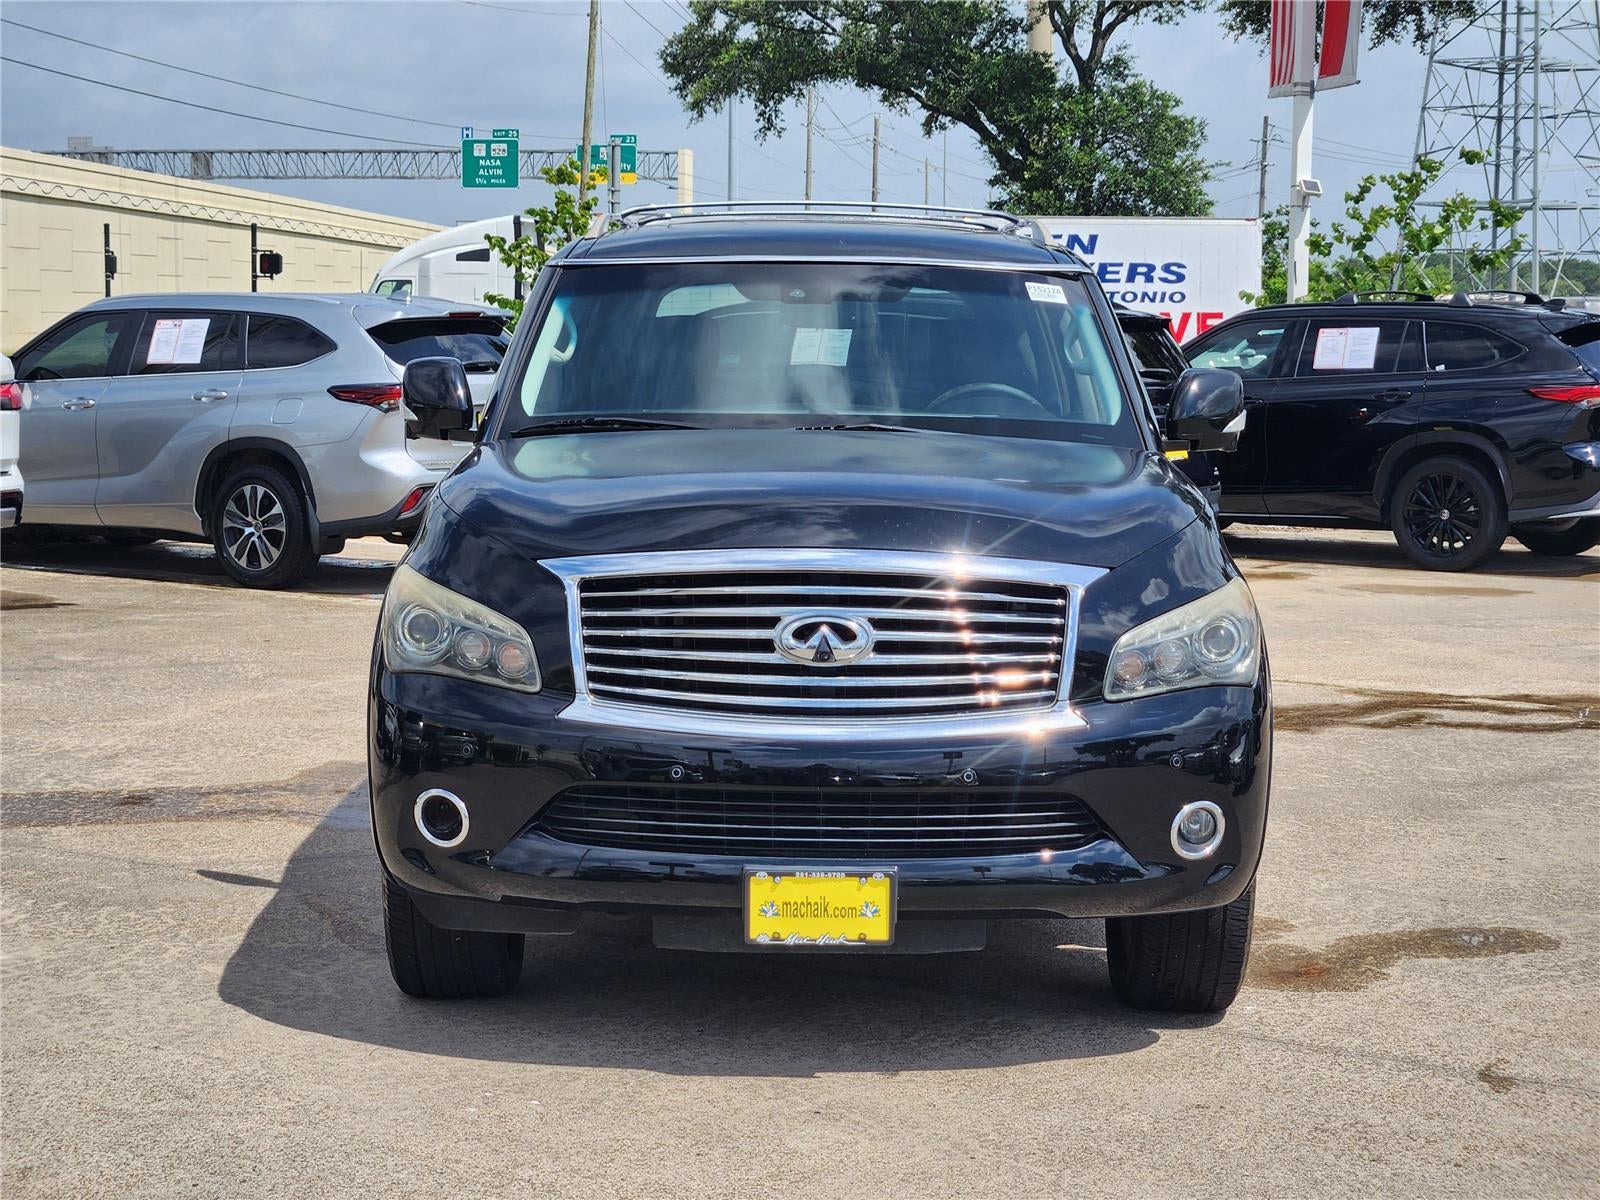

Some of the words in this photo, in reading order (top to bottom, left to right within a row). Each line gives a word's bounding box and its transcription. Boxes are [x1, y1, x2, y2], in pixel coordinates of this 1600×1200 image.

[478, 168, 503, 176] ALVIN
[781, 895, 858, 919] machaik.com
[783, 932, 811, 945] Mac
